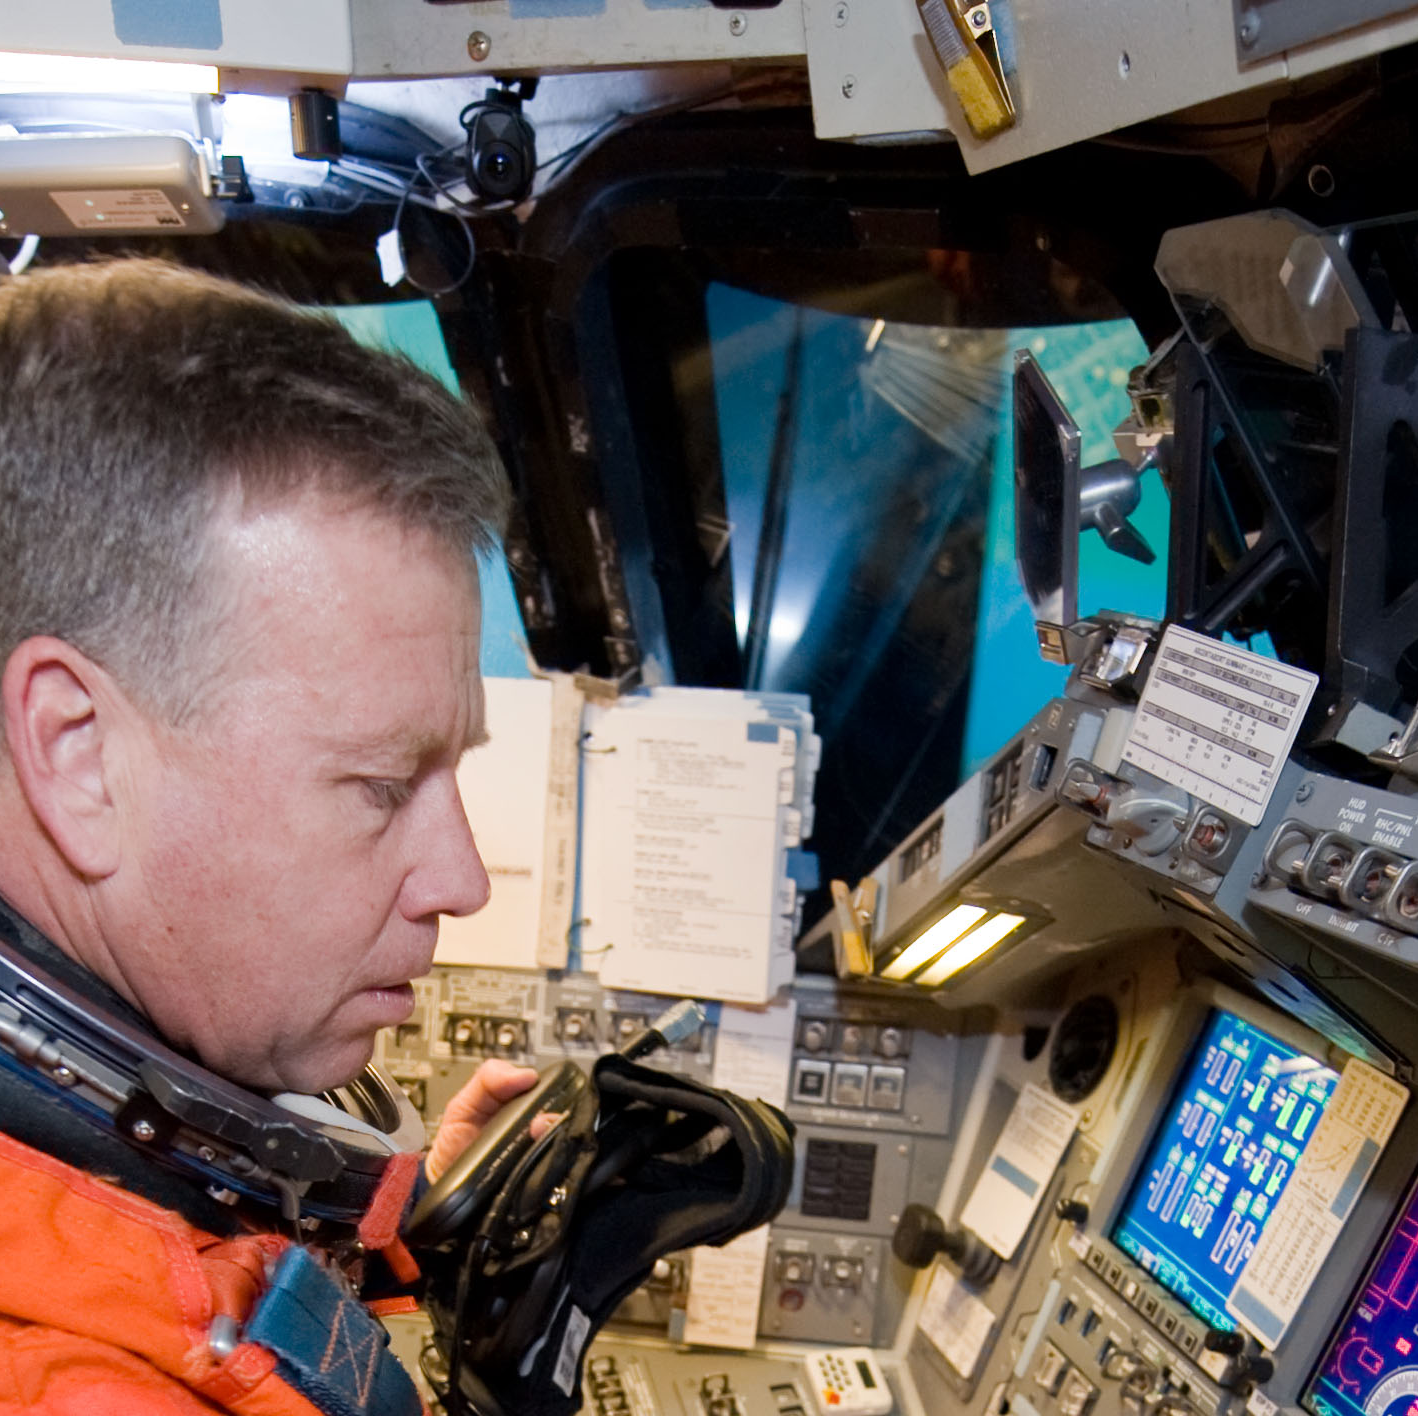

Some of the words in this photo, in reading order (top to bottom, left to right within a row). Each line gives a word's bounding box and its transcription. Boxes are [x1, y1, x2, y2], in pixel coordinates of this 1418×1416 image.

[1347, 795, 1367, 811] HUD
[1336, 806, 1365, 823] POWER
[1338, 821, 1353, 833] ON
[1374, 817, 1412, 837] RHC/PNL
[1371, 830, 1403, 848] ENABLE
[1295, 902, 1311, 916] OFF
[1327, 914, 1359, 933] INHIBIT
